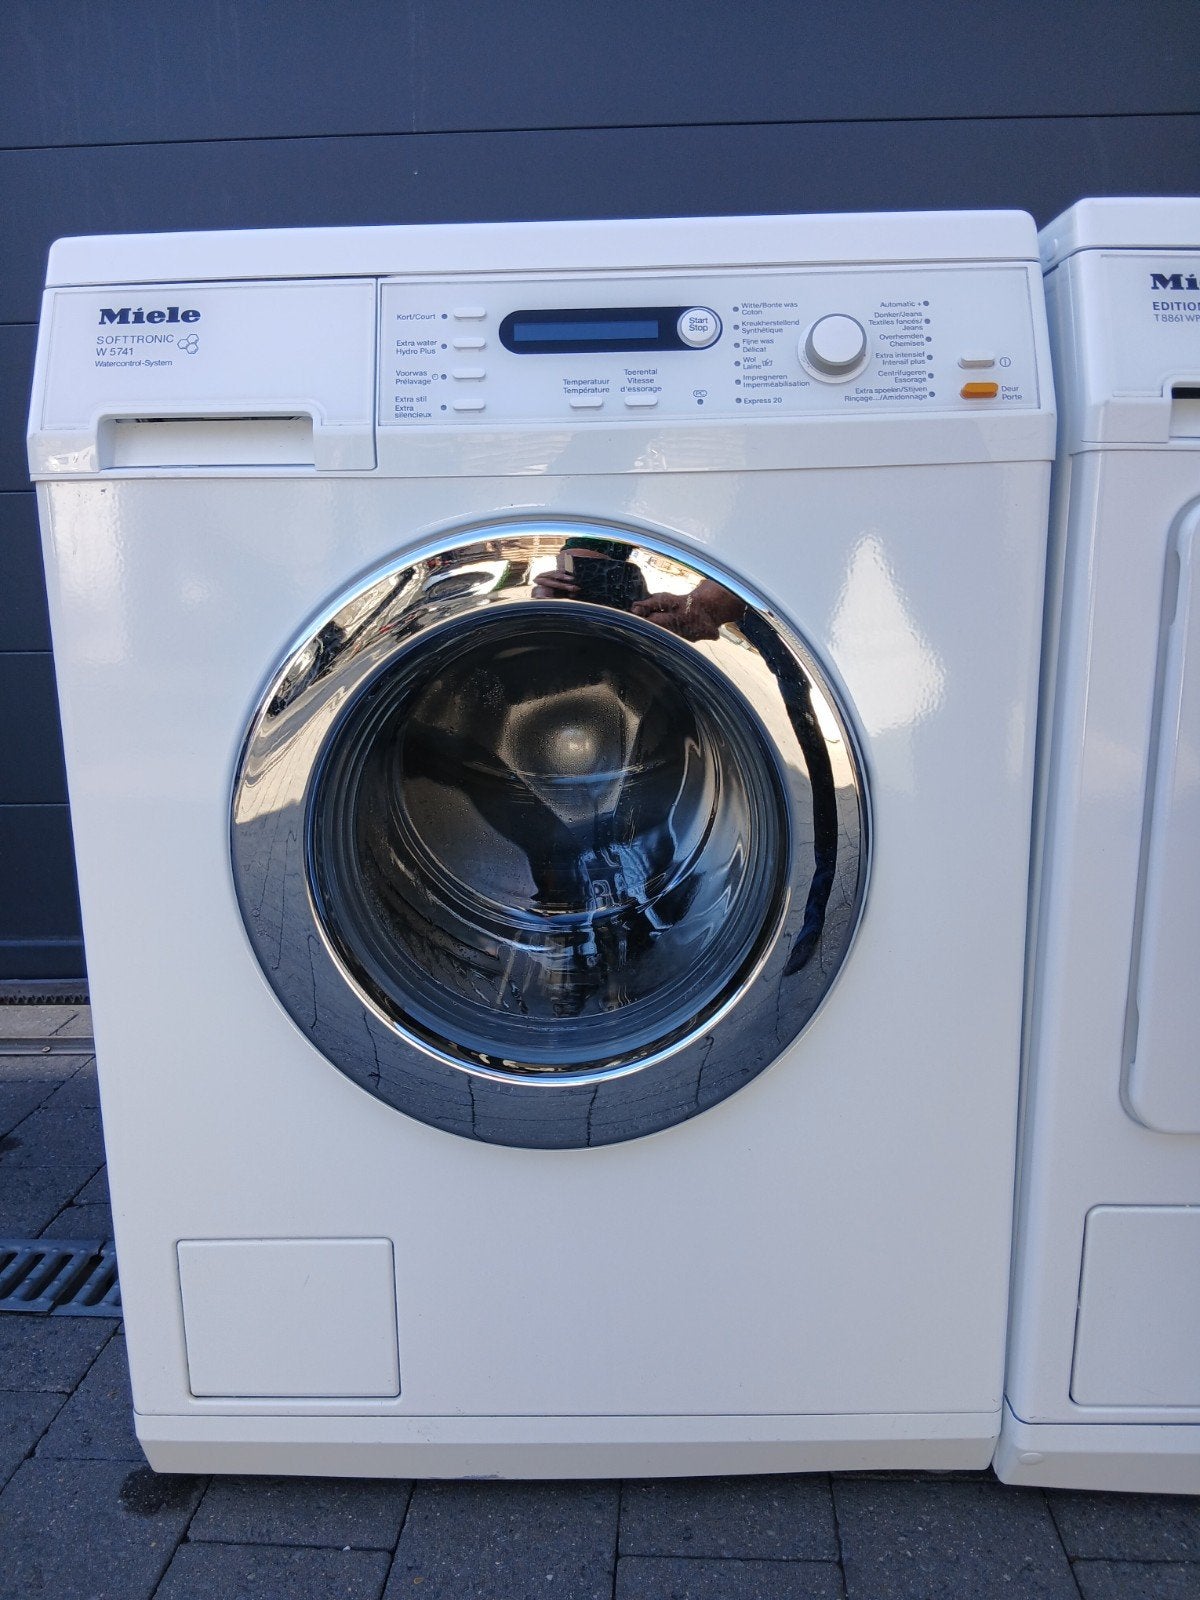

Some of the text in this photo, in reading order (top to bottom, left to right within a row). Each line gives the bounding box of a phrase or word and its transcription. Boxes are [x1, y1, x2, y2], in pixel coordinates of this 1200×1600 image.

[1150, 273, 1200, 290] Mi
[98, 306, 201, 325] Miele
[741, 308, 763, 316] Coton
[873, 311, 923, 319] Donker/Jeans
[396, 313, 436, 321] Kort/Court
[688, 316, 708, 324] Start
[1161, 314, 1184, 323] 8861
[688, 323, 709, 333] Stop
[96, 334, 174, 345] SOFTTRONIC
[879, 333, 925, 341] Overhemden
[396, 339, 437, 347] Extra water
[96, 347, 133, 356] W 5741
[396, 347, 436, 356] Hydro Plus
[94, 359, 173, 368] Watercontrol-System
[742, 362, 762, 370] Laine
[910, 358, 926, 366] plus
[395, 369, 428, 377] Voorwas
[623, 368, 658, 376] Toerental
[877, 370, 927, 378] Centrifugeren
[627, 376, 655, 384] Vitesse
[743, 374, 788, 382] Impregneren
[894, 376, 927, 384] Essorage
[562, 378, 610, 387] Temperatuur
[562, 386, 610, 394] Température
[620, 385, 663, 394] d'essorage
[394, 411, 432, 419] silencieux
